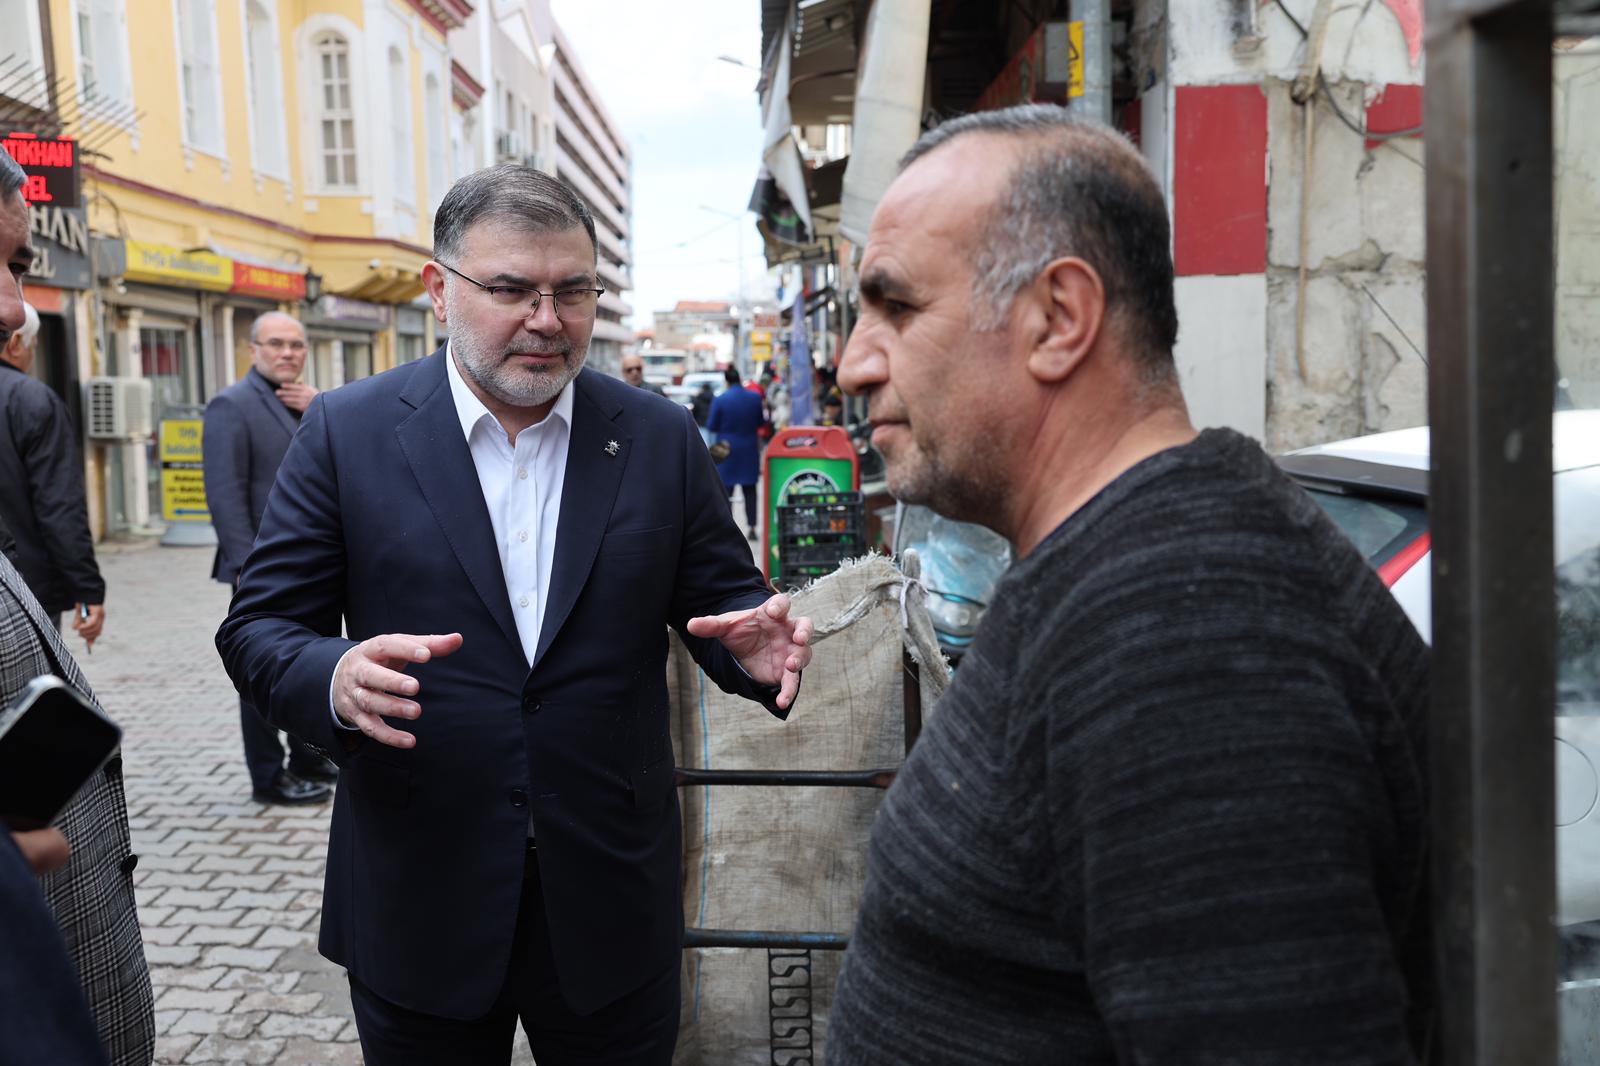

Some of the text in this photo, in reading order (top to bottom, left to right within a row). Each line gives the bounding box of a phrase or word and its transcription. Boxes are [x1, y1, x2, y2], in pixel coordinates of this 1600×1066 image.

[2, 139, 72, 167] TIKHAN
[29, 205, 88, 256] HAN
[29, 246, 56, 278] EL
